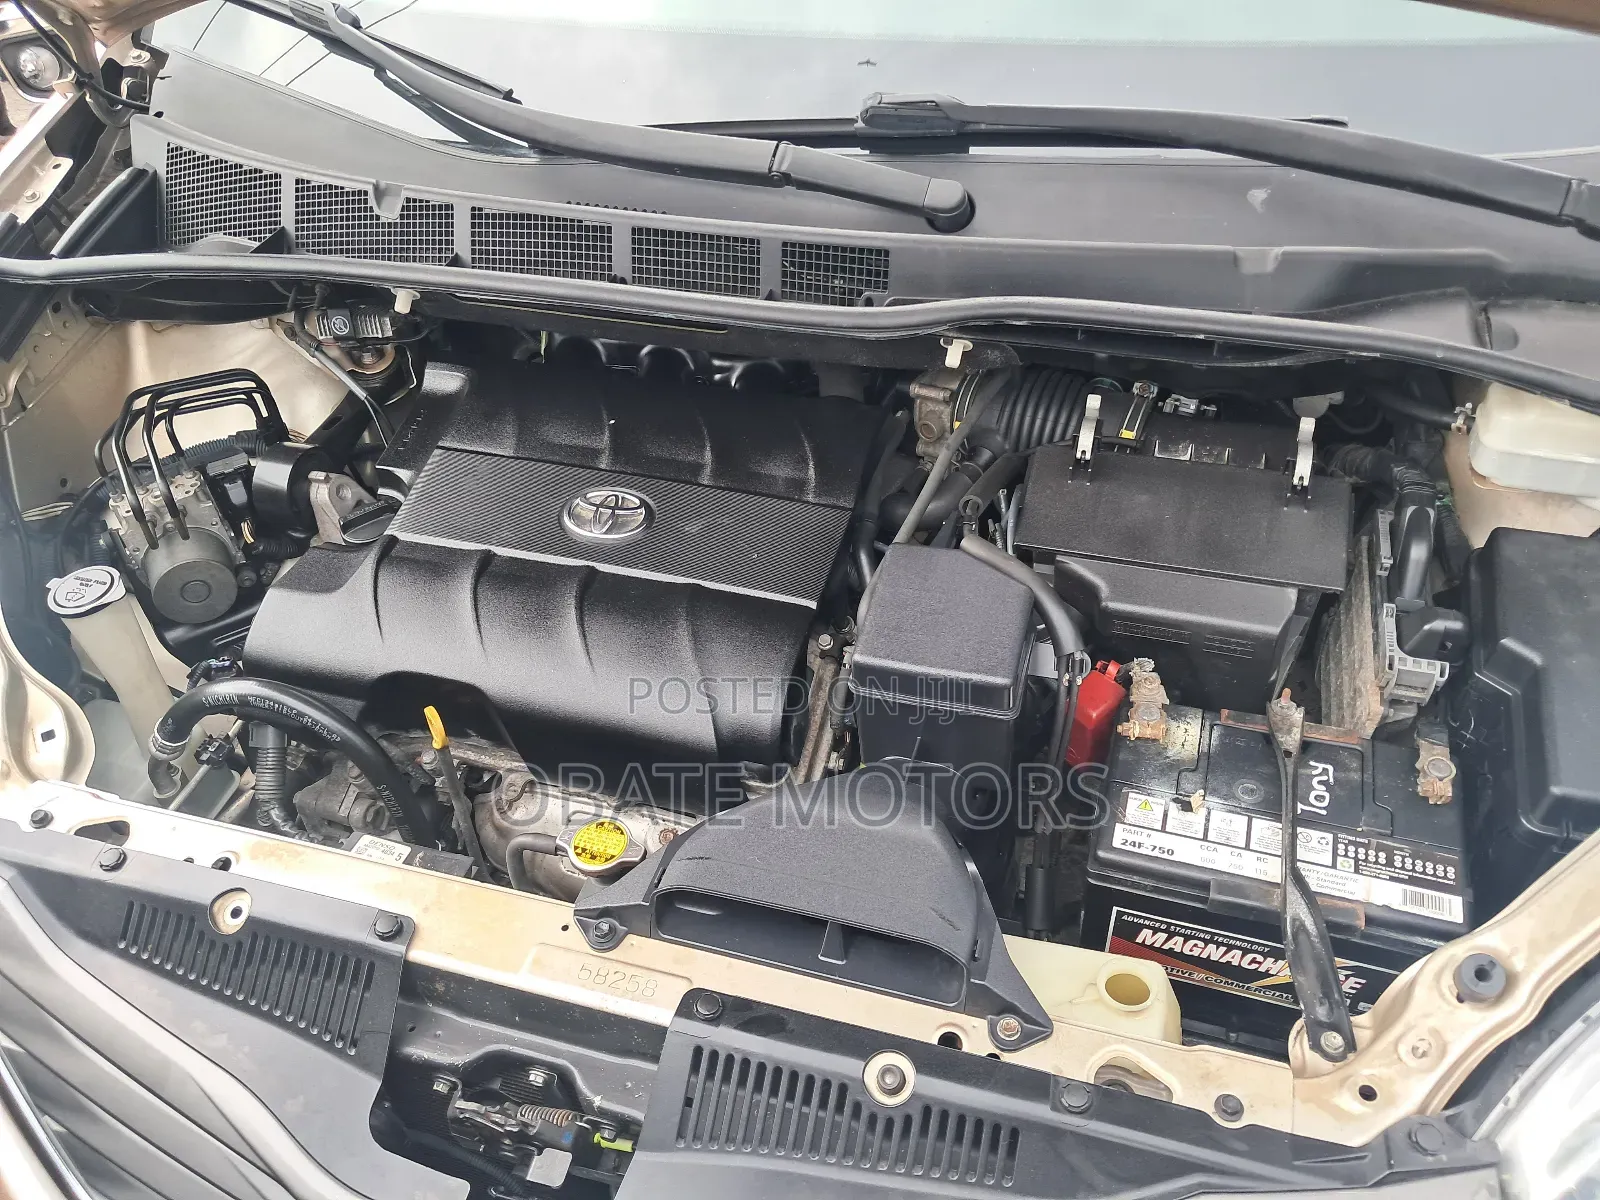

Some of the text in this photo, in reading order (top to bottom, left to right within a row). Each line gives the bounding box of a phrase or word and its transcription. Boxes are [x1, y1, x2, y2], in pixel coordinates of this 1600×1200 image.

[1122, 827, 1143, 837] PART
[1120, 838, 1175, 856] 24F-750
[1200, 844, 1218, 853] CCA
[1230, 851, 1242, 859] CA
[1121, 914, 1271, 953] ADVANCED STARTING TECHNOLOGY
[1135, 928, 1367, 994] MAGNACHE
